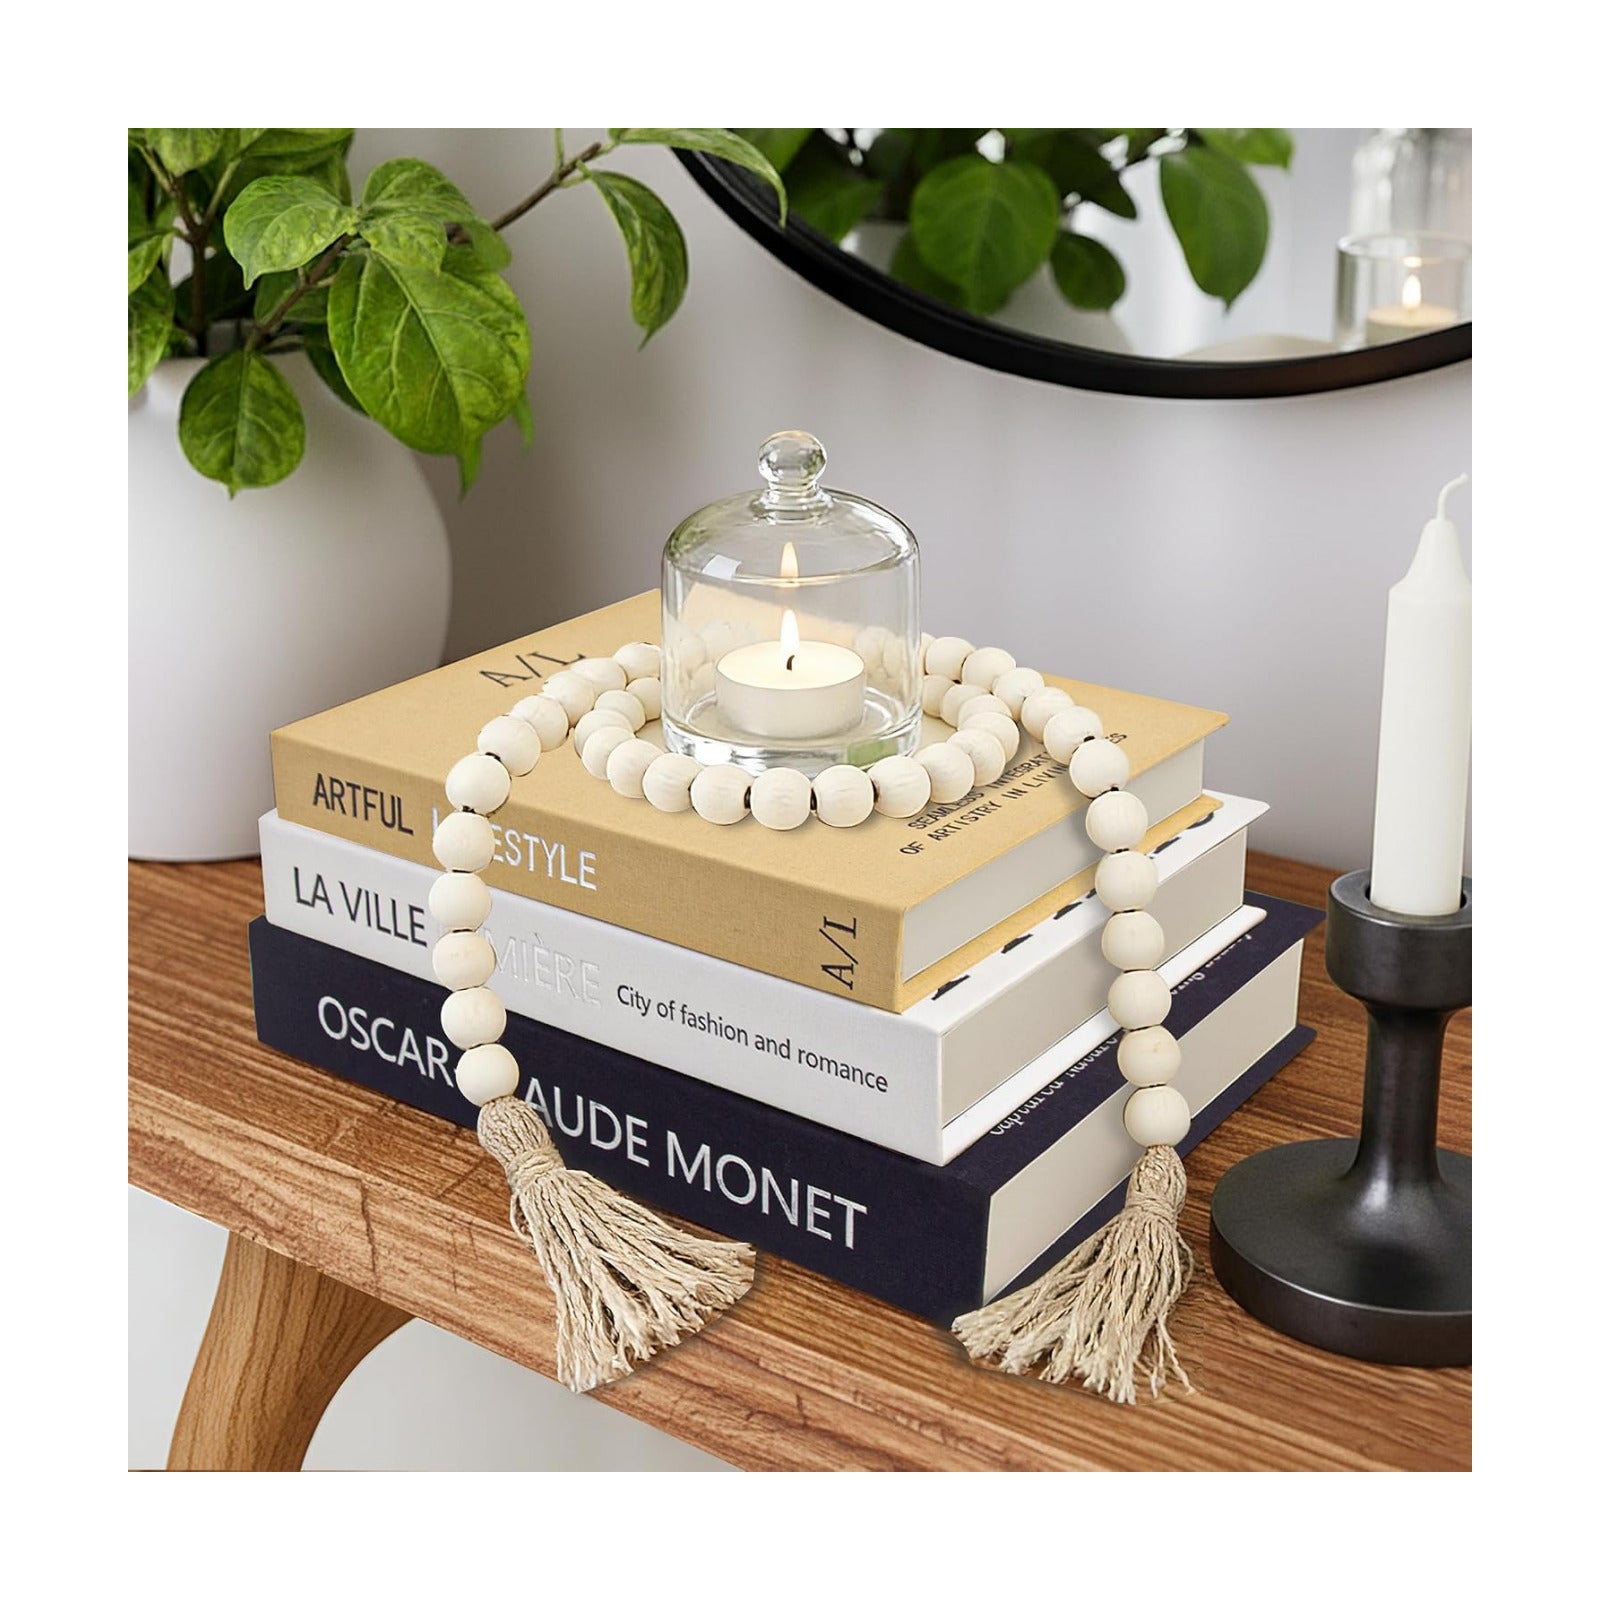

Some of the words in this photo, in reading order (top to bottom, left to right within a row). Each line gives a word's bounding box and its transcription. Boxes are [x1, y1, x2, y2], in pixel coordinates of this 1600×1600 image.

[479, 651, 586, 688] A/L
[900, 841, 924, 855] OF
[927, 800, 1002, 841] ARTISTRY
[1001, 788, 1028, 800] IN
[1022, 763, 1070, 788] LIVIN
[986, 751, 1053, 789] INTEGRAT
[312, 772, 414, 836] ARTFUL
[431, 807, 597, 891] LESTYLE
[293, 866, 333, 915] LA
[338, 881, 428, 948] VILLE
[484, 927, 600, 1005] MIÈRE
[819, 916, 858, 991] A/L
[616, 984, 652, 1017] City
[656, 1000, 676, 1021] of
[679, 1004, 749, 1047] fashion
[754, 1034, 791, 1060] and
[797, 1049, 889, 1093] romance
[523, 1076, 651, 1168] AUDE
[666, 1129, 868, 1250] MONET
